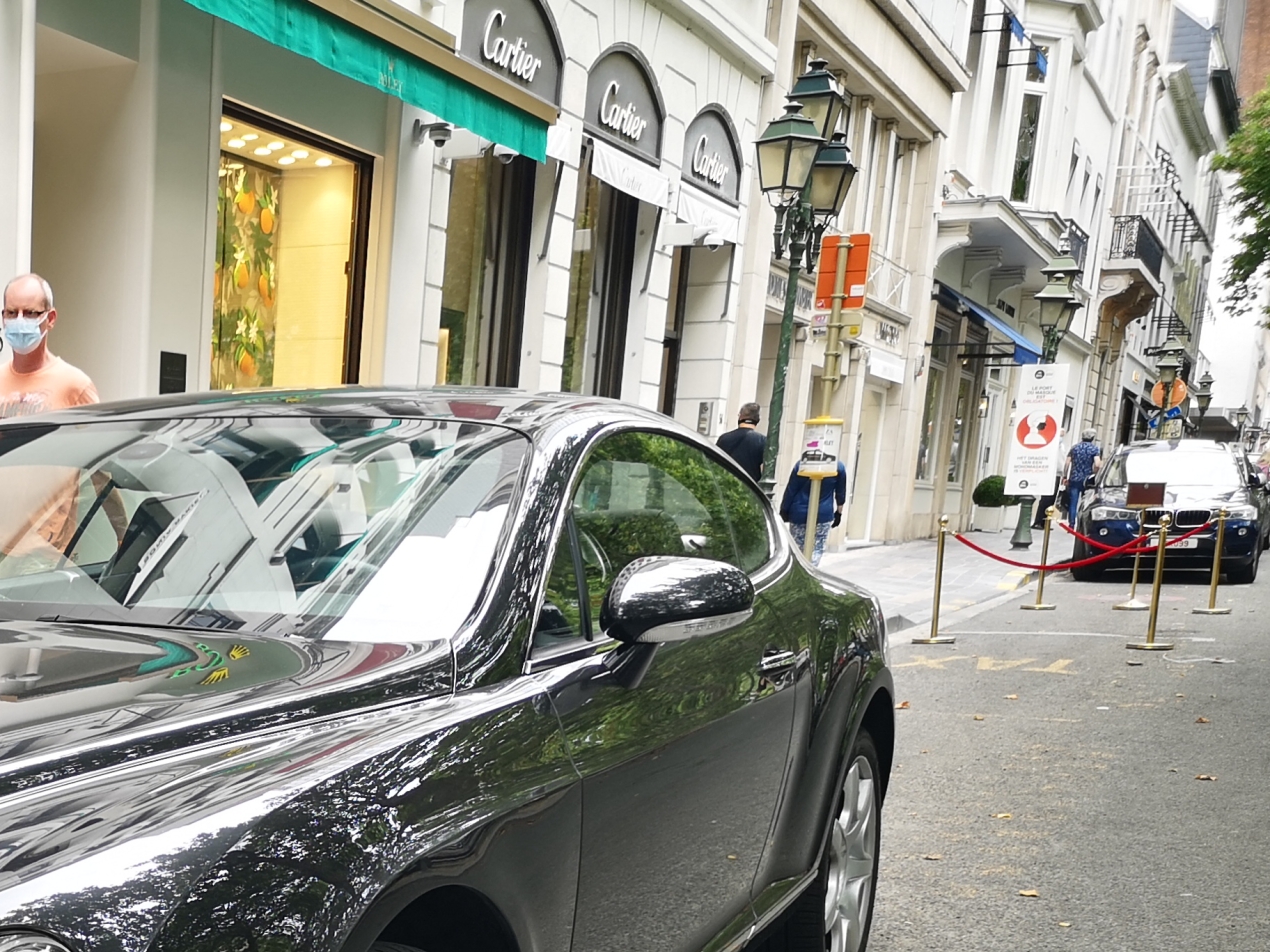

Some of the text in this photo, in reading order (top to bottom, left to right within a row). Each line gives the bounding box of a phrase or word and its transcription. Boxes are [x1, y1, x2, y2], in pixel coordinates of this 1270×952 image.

[483, 9, 541, 82] Cartier
[600, 80, 647, 141] Cartier
[693, 134, 729, 186] Cartier
